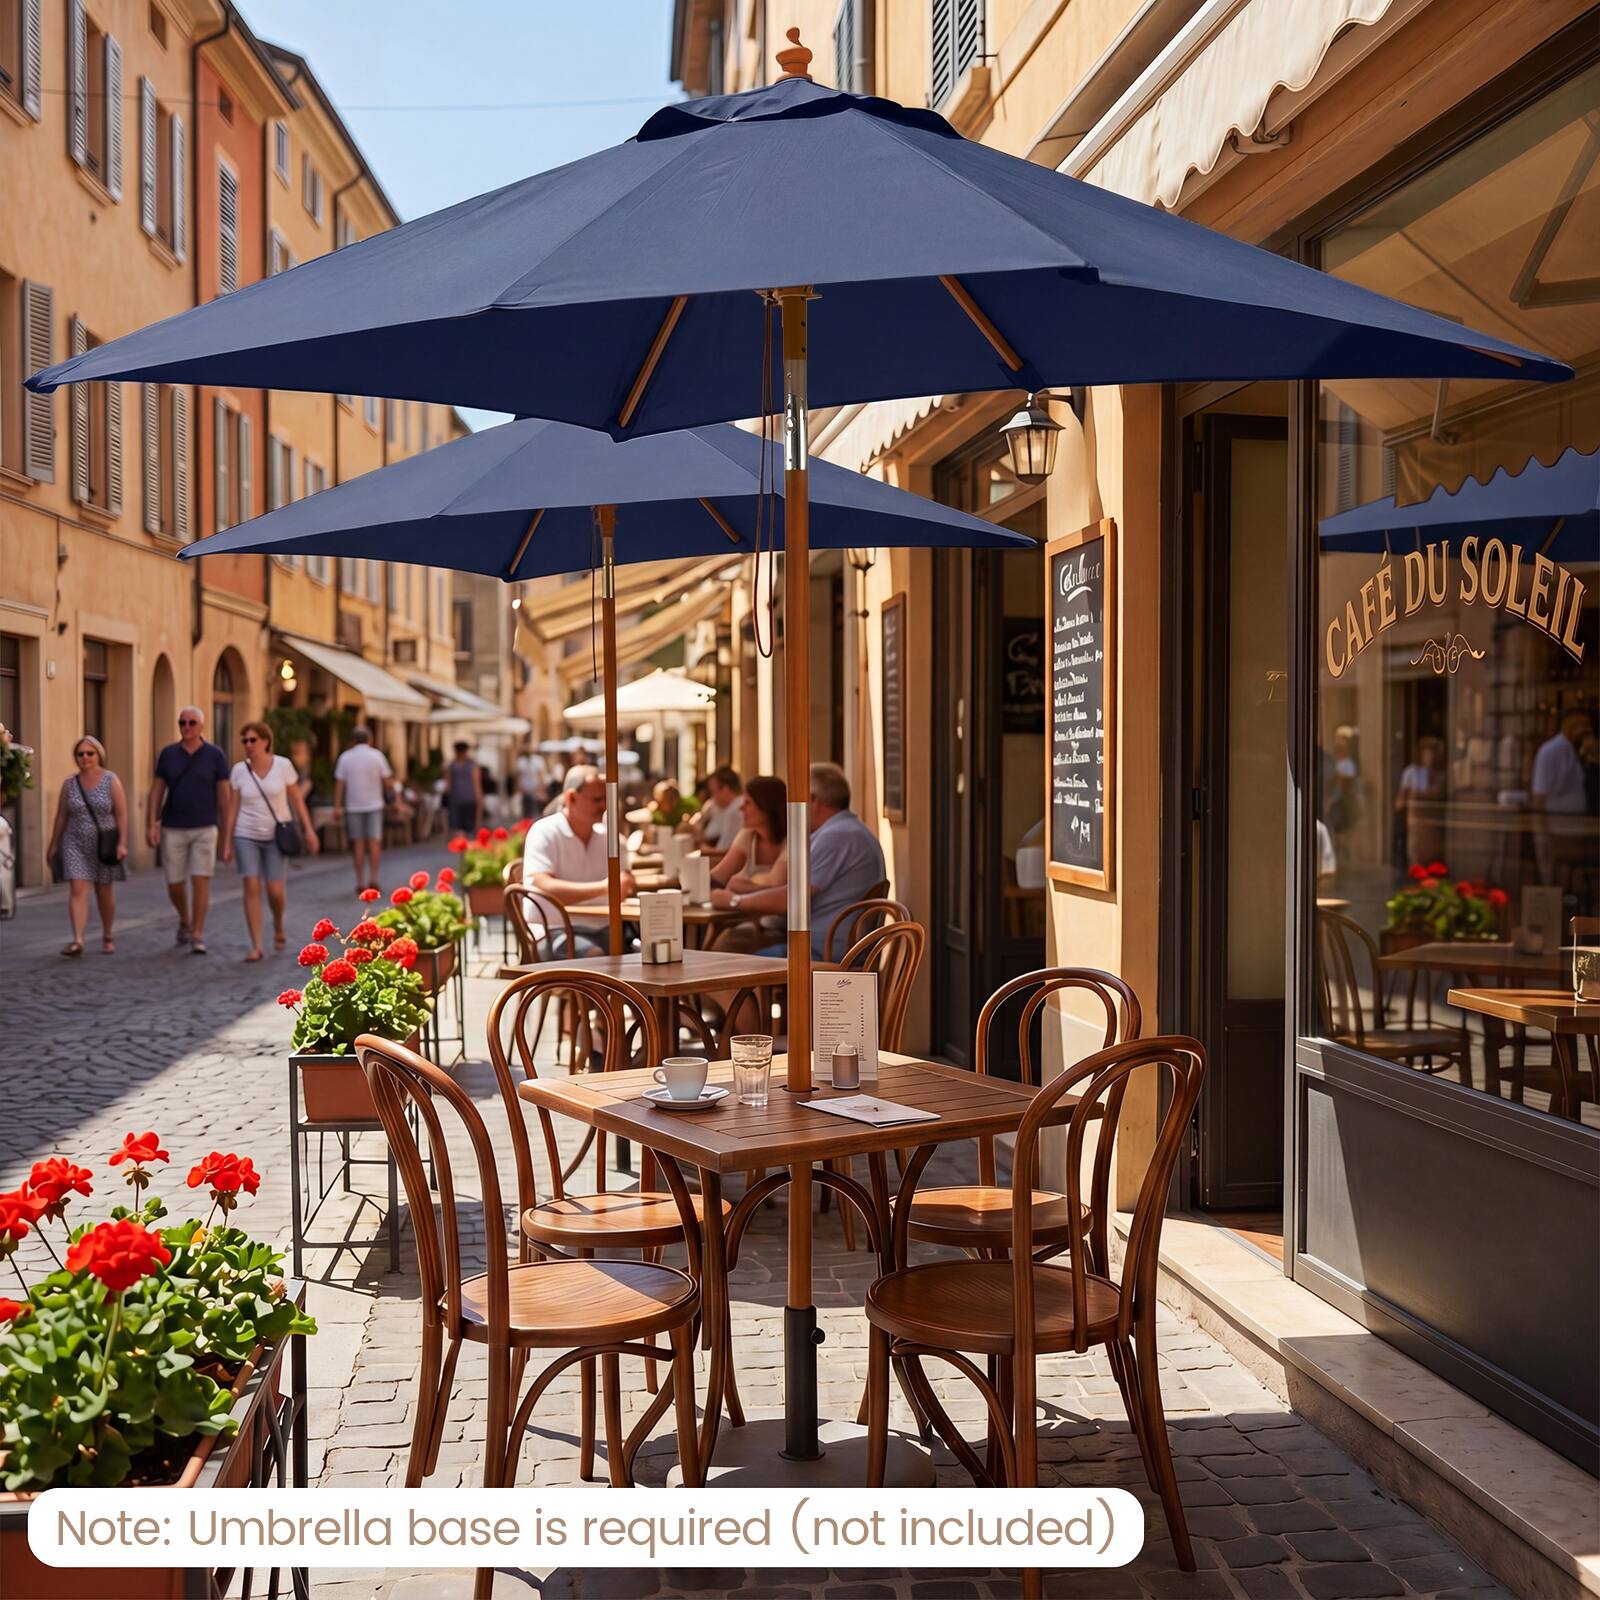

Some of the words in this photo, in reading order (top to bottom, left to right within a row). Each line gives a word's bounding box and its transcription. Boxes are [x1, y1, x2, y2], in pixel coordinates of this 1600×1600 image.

[1325, 550, 1397, 678] CAFÉ
[1404, 540, 1450, 616] DU
[1460, 535, 1587, 662] SOLEIL
